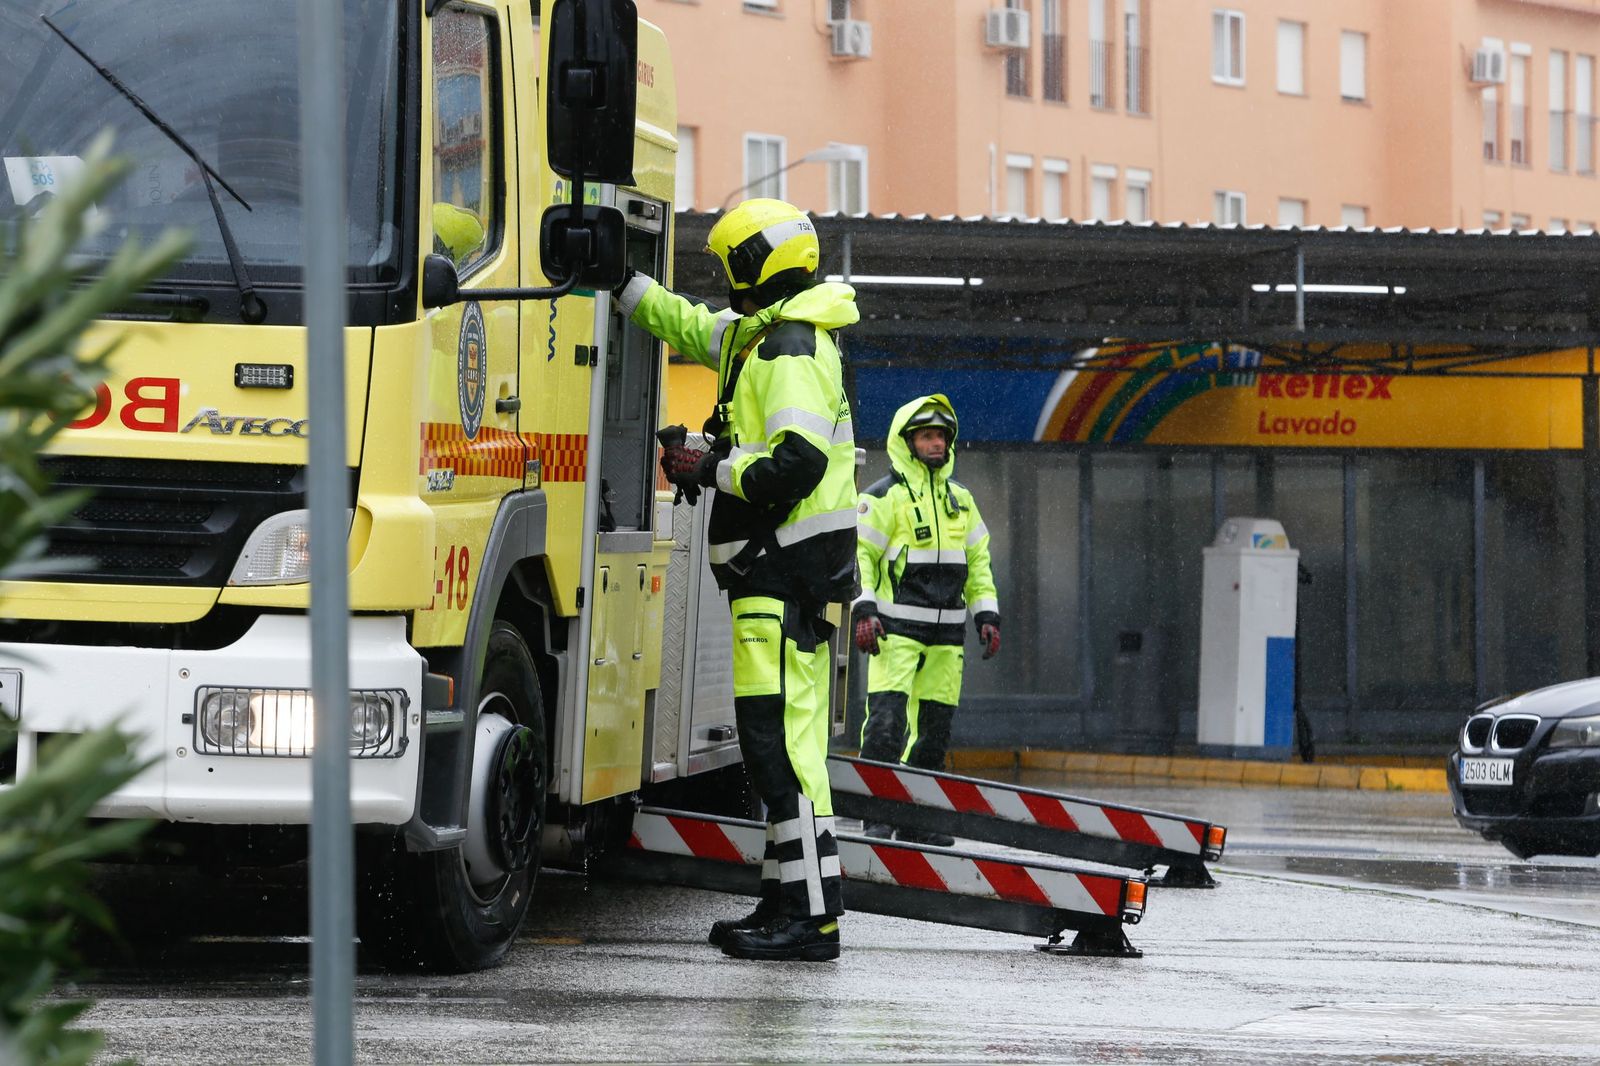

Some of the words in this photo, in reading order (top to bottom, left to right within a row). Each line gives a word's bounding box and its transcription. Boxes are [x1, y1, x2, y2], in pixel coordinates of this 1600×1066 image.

[32, 174, 55, 185] SOS
[1257, 367, 1394, 399] Reflex
[1258, 410, 1358, 435] Lavado
[420, 545, 470, 611] -18
[1465, 762, 1487, 780] 2503
[1490, 763, 1510, 781] GLM
